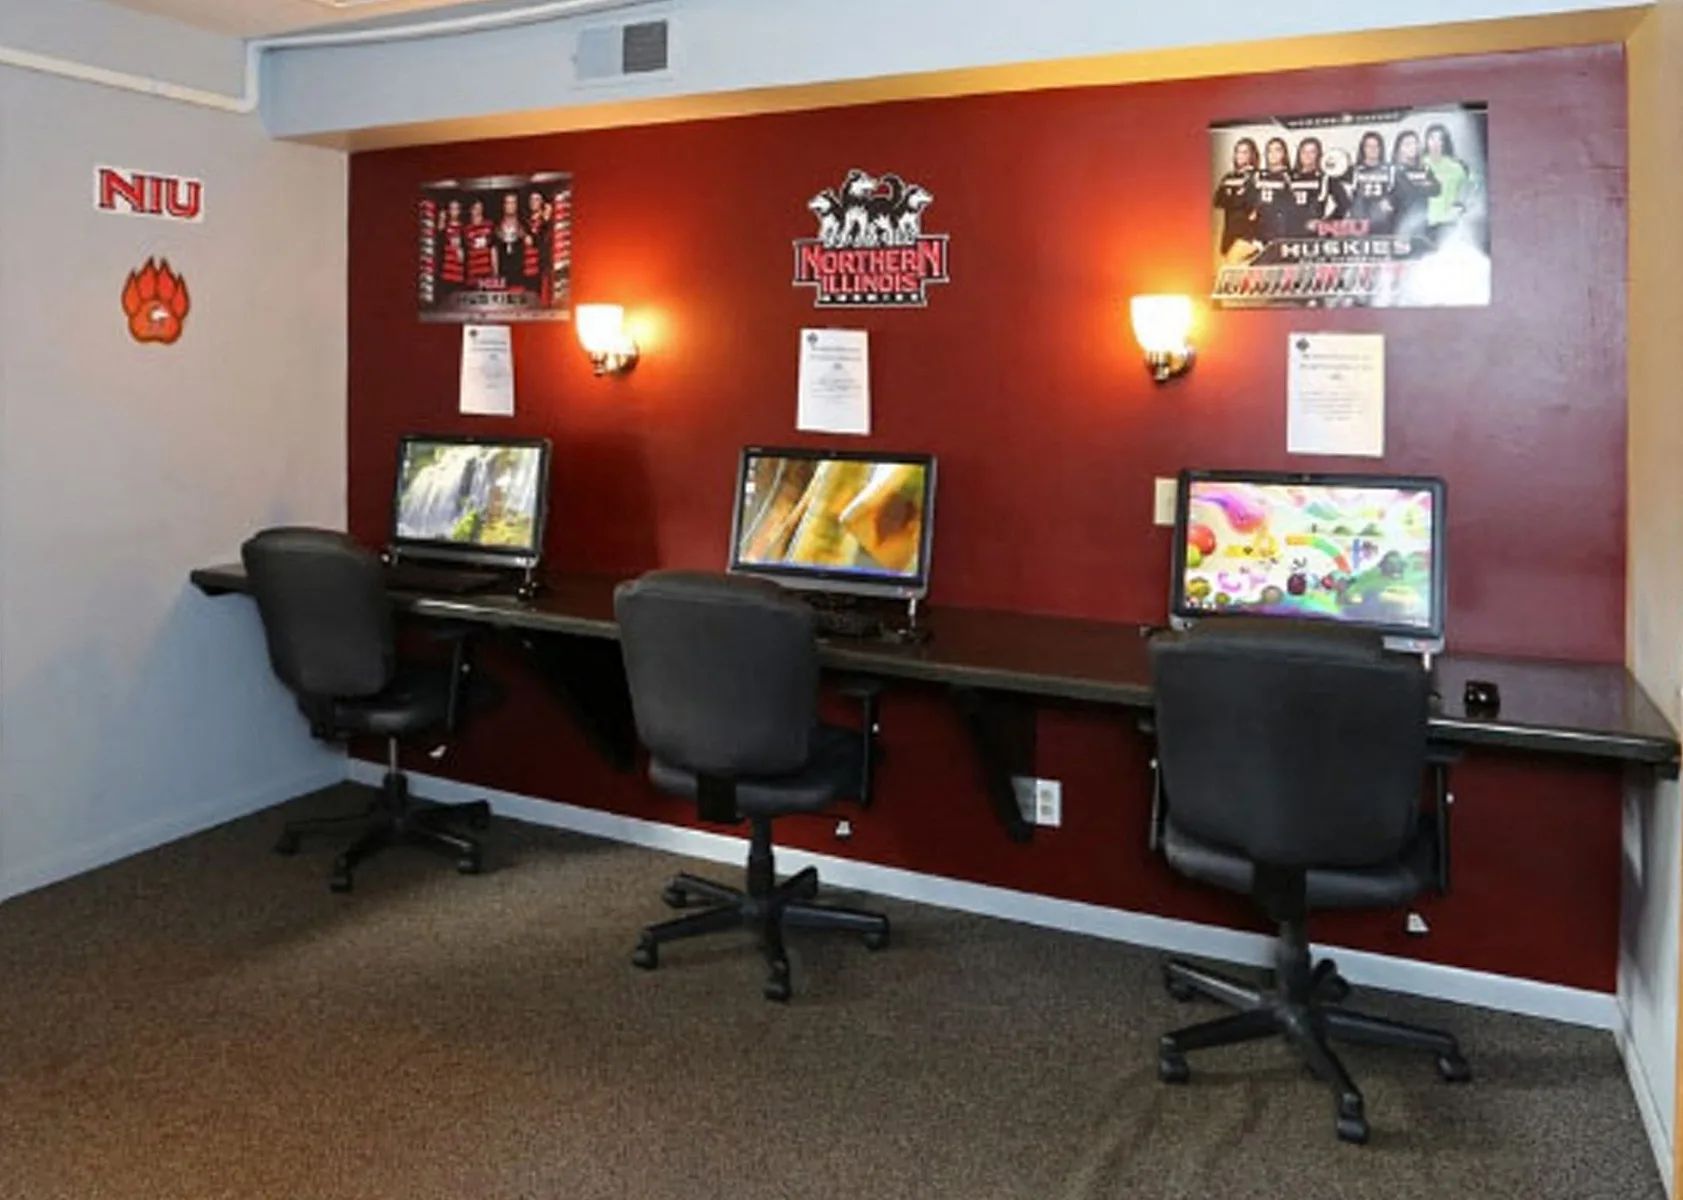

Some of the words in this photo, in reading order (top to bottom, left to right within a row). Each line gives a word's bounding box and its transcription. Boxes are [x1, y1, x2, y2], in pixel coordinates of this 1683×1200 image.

[99, 168, 201, 218] NIU
[801, 241, 941, 280] NORTHERN
[1280, 240, 1412, 257] HUSKIES
[821, 272, 919, 294] ILLINOIS
